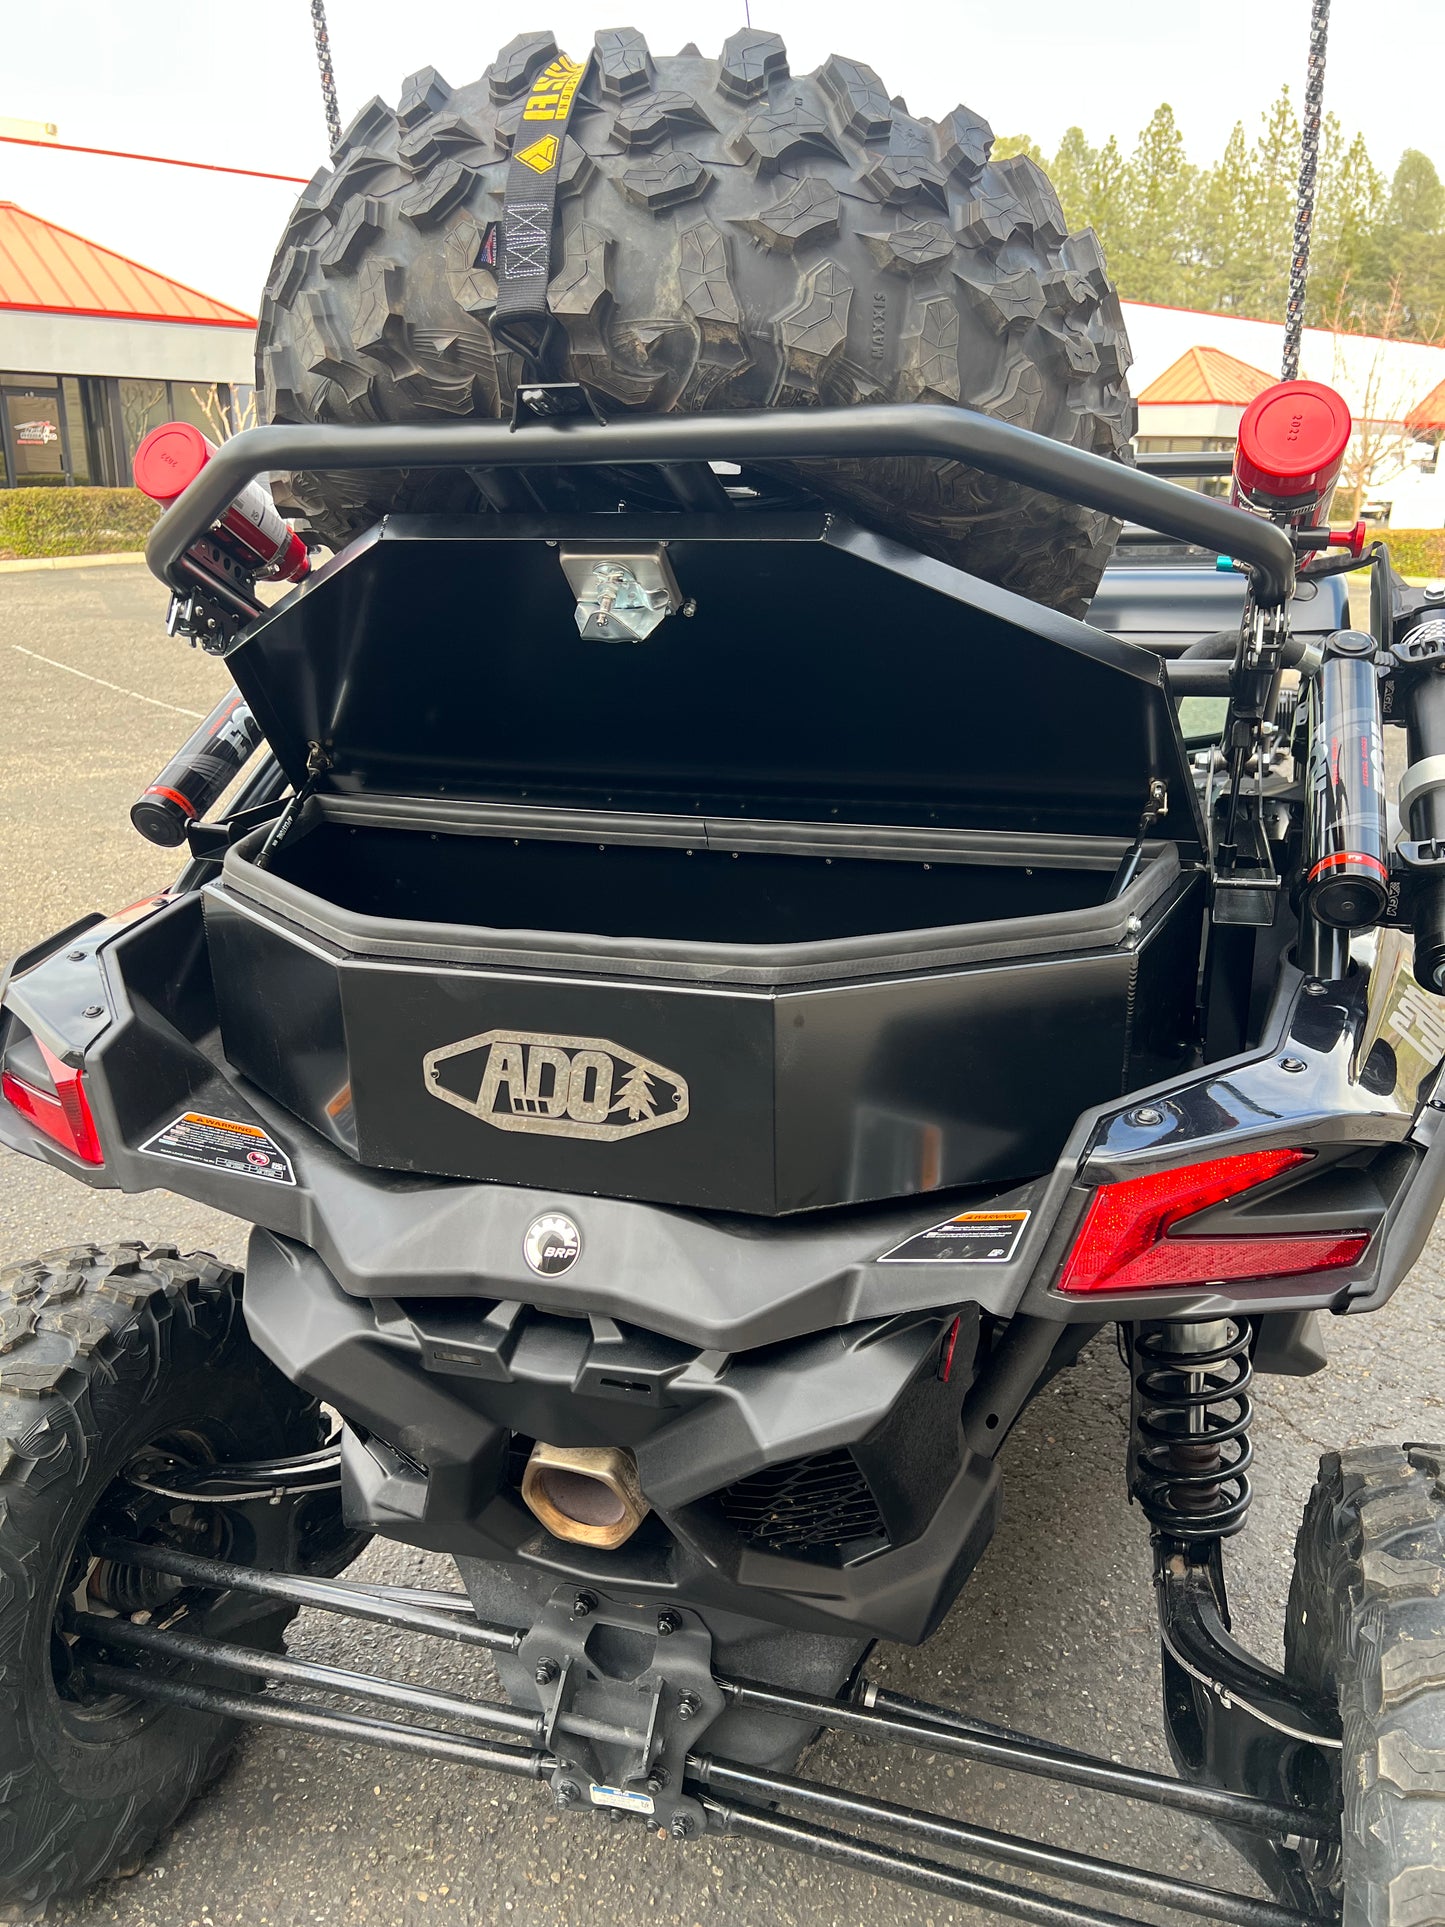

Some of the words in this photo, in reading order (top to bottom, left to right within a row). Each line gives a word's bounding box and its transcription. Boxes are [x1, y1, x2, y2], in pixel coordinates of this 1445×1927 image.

[872, 292, 885, 359] MAXXIS
[1287, 414, 1303, 442] 2022
[1383, 686, 1394, 713] AGM
[216, 701, 262, 762] FO
[1387, 888, 1399, 917] AGM
[477, 1042, 614, 1123] ADO
[205, 1118, 252, 1134] WARNING
[544, 1246, 577, 1259] BRP
